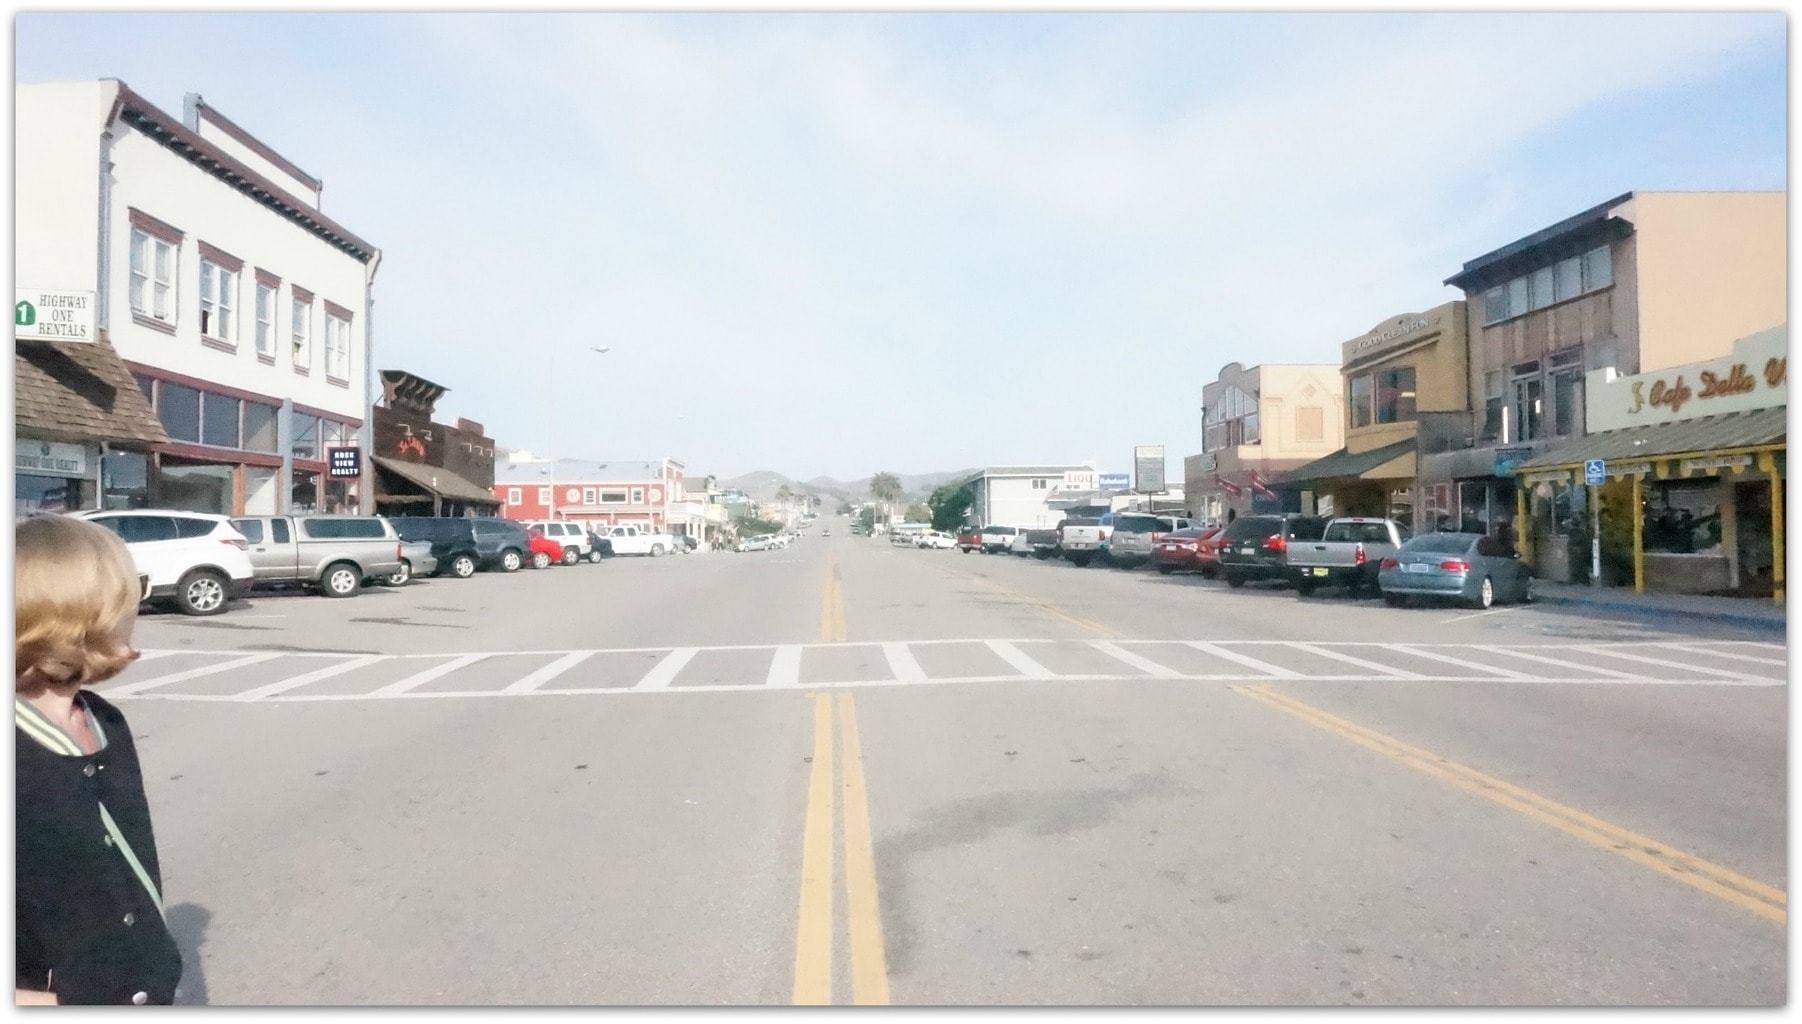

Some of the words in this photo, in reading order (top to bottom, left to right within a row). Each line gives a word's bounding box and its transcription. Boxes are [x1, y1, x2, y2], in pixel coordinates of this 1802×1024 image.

[39, 294, 88, 309] HIGHWAY
[17, 304, 28, 323] 1
[52, 309, 74, 322] ONE
[38, 322, 87, 337] RENTALS
[1383, 325, 1412, 341] CLEAN
[1649, 374, 1693, 413] Cafe
[1697, 363, 1757, 399] Della
[334, 451, 355, 459] ROCK
[331, 468, 359, 476] REALTY
